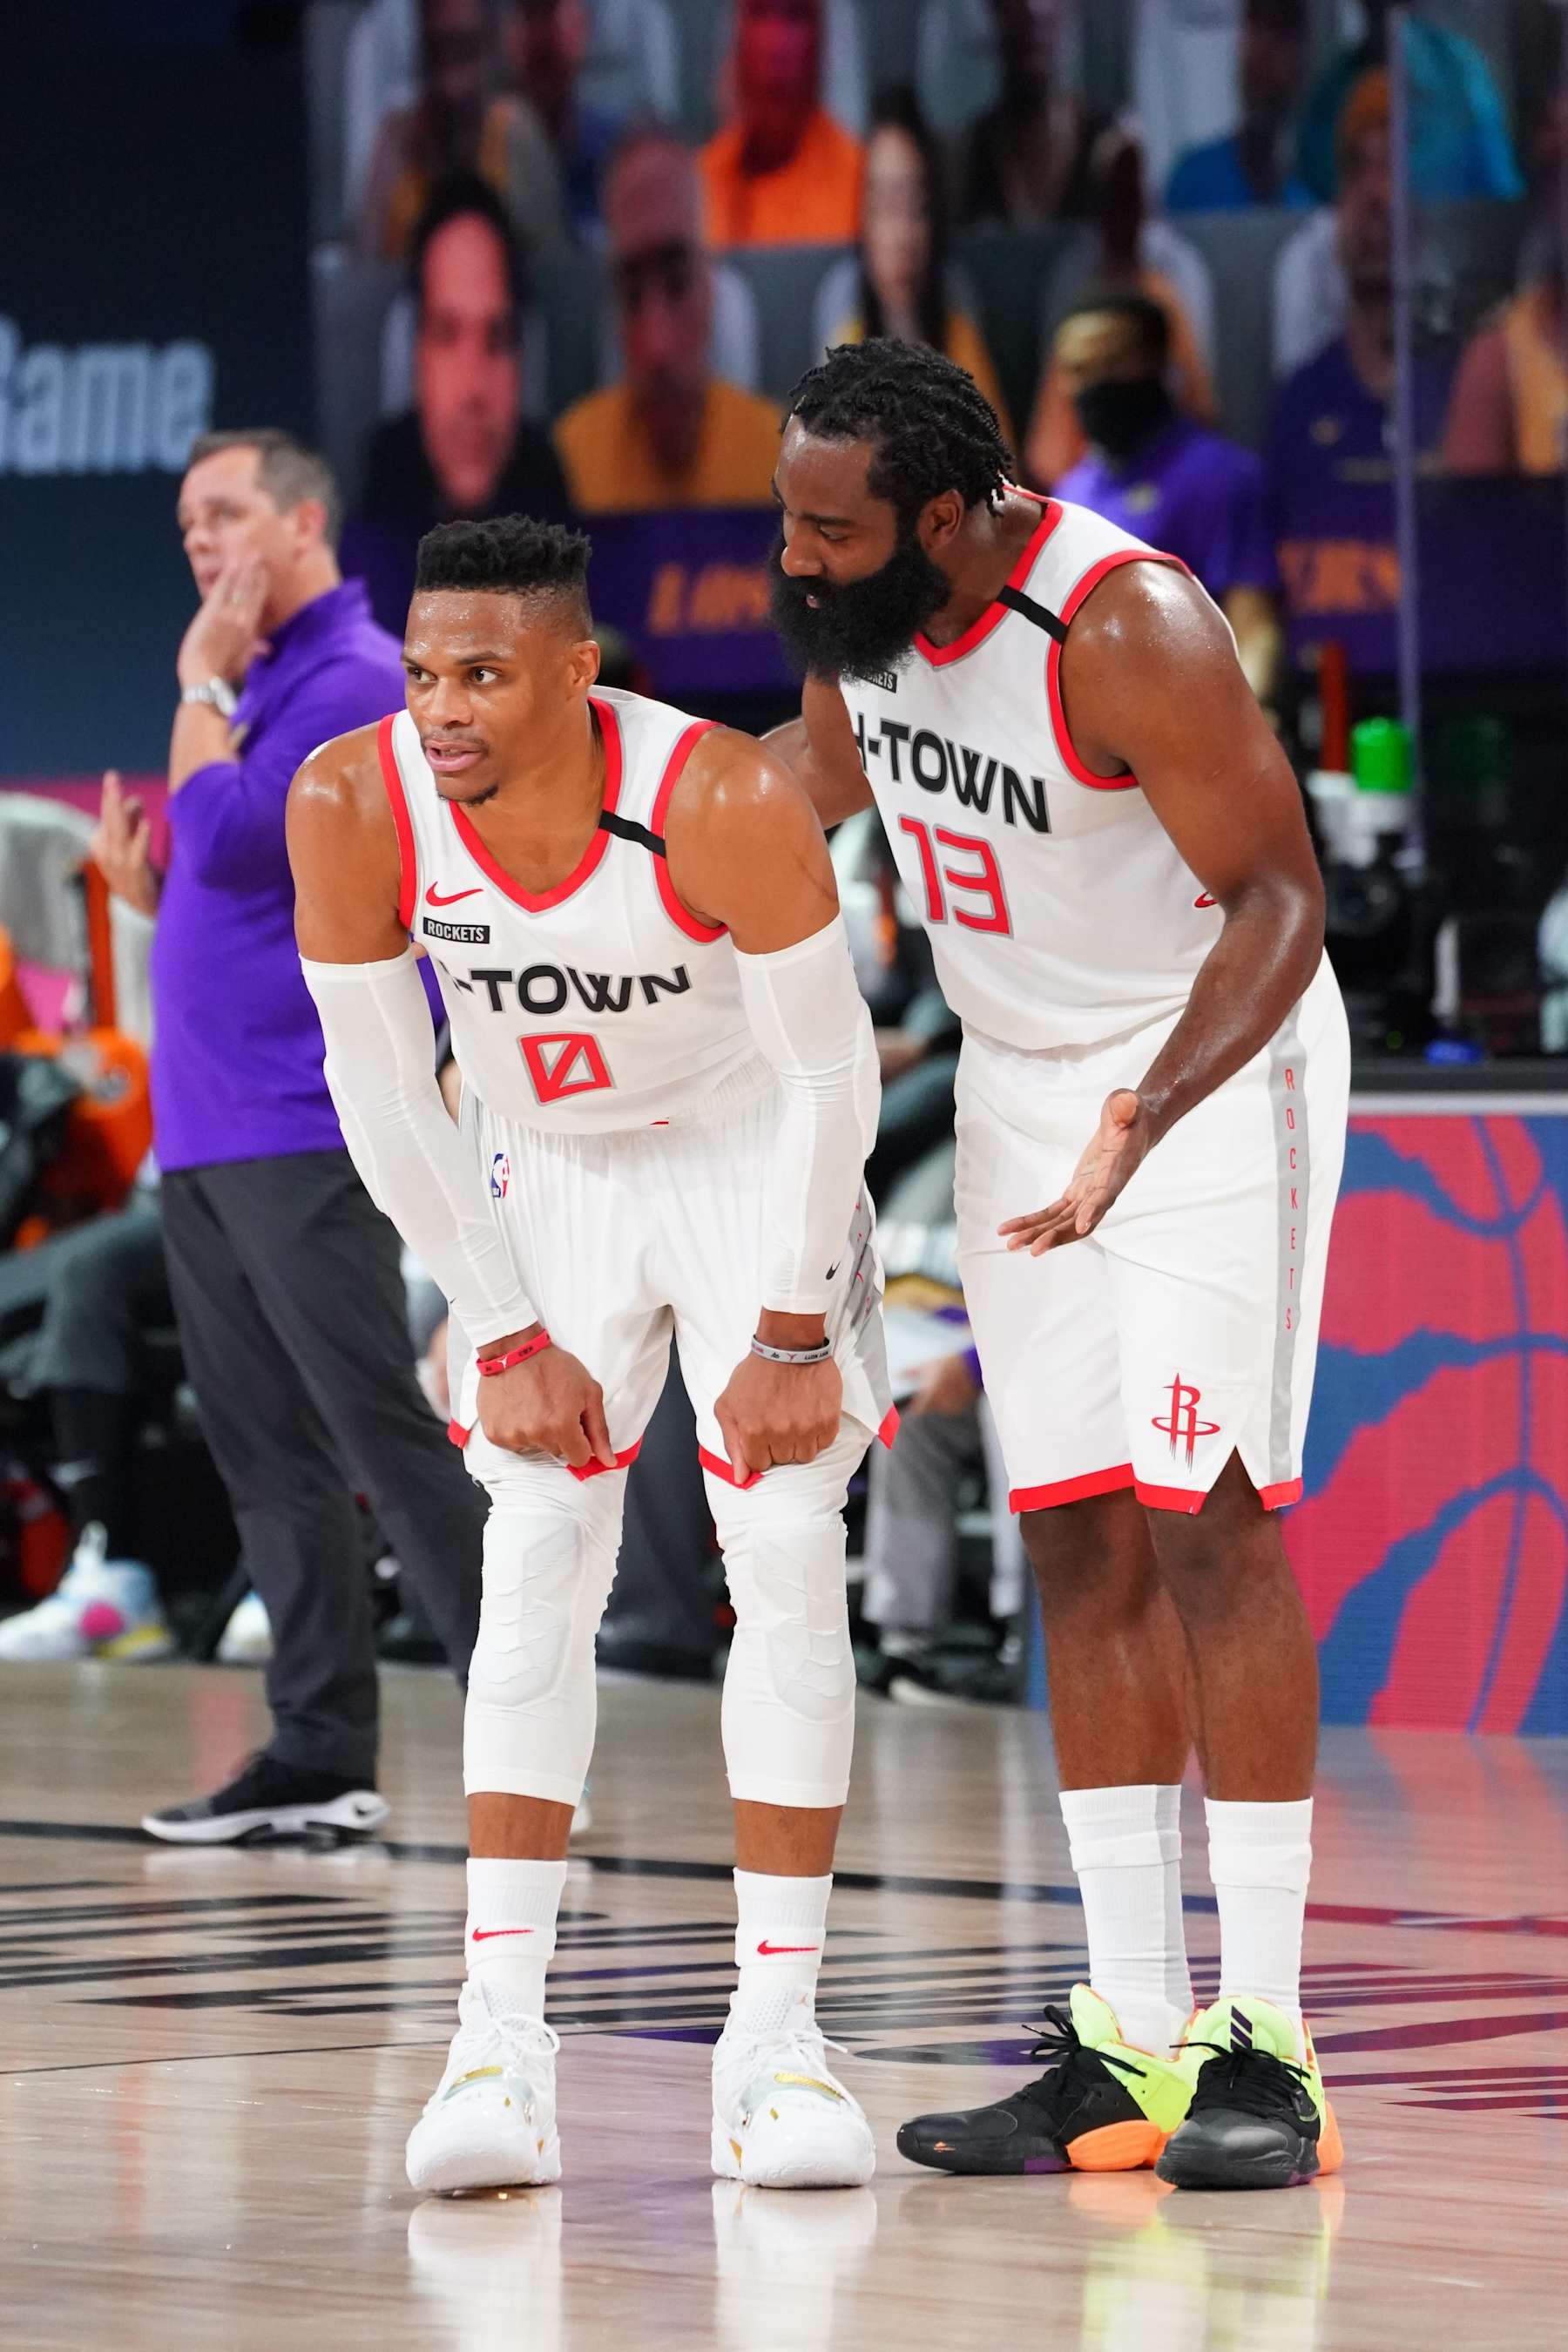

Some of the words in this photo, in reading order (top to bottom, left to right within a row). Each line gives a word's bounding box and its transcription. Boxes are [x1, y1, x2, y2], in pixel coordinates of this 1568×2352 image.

[897, 814, 1014, 939] 13
[427, 920, 484, 942] ROCKETS
[436, 958, 693, 1015] -TOWN
[1284, 1068, 1299, 1330] ROCKETS
